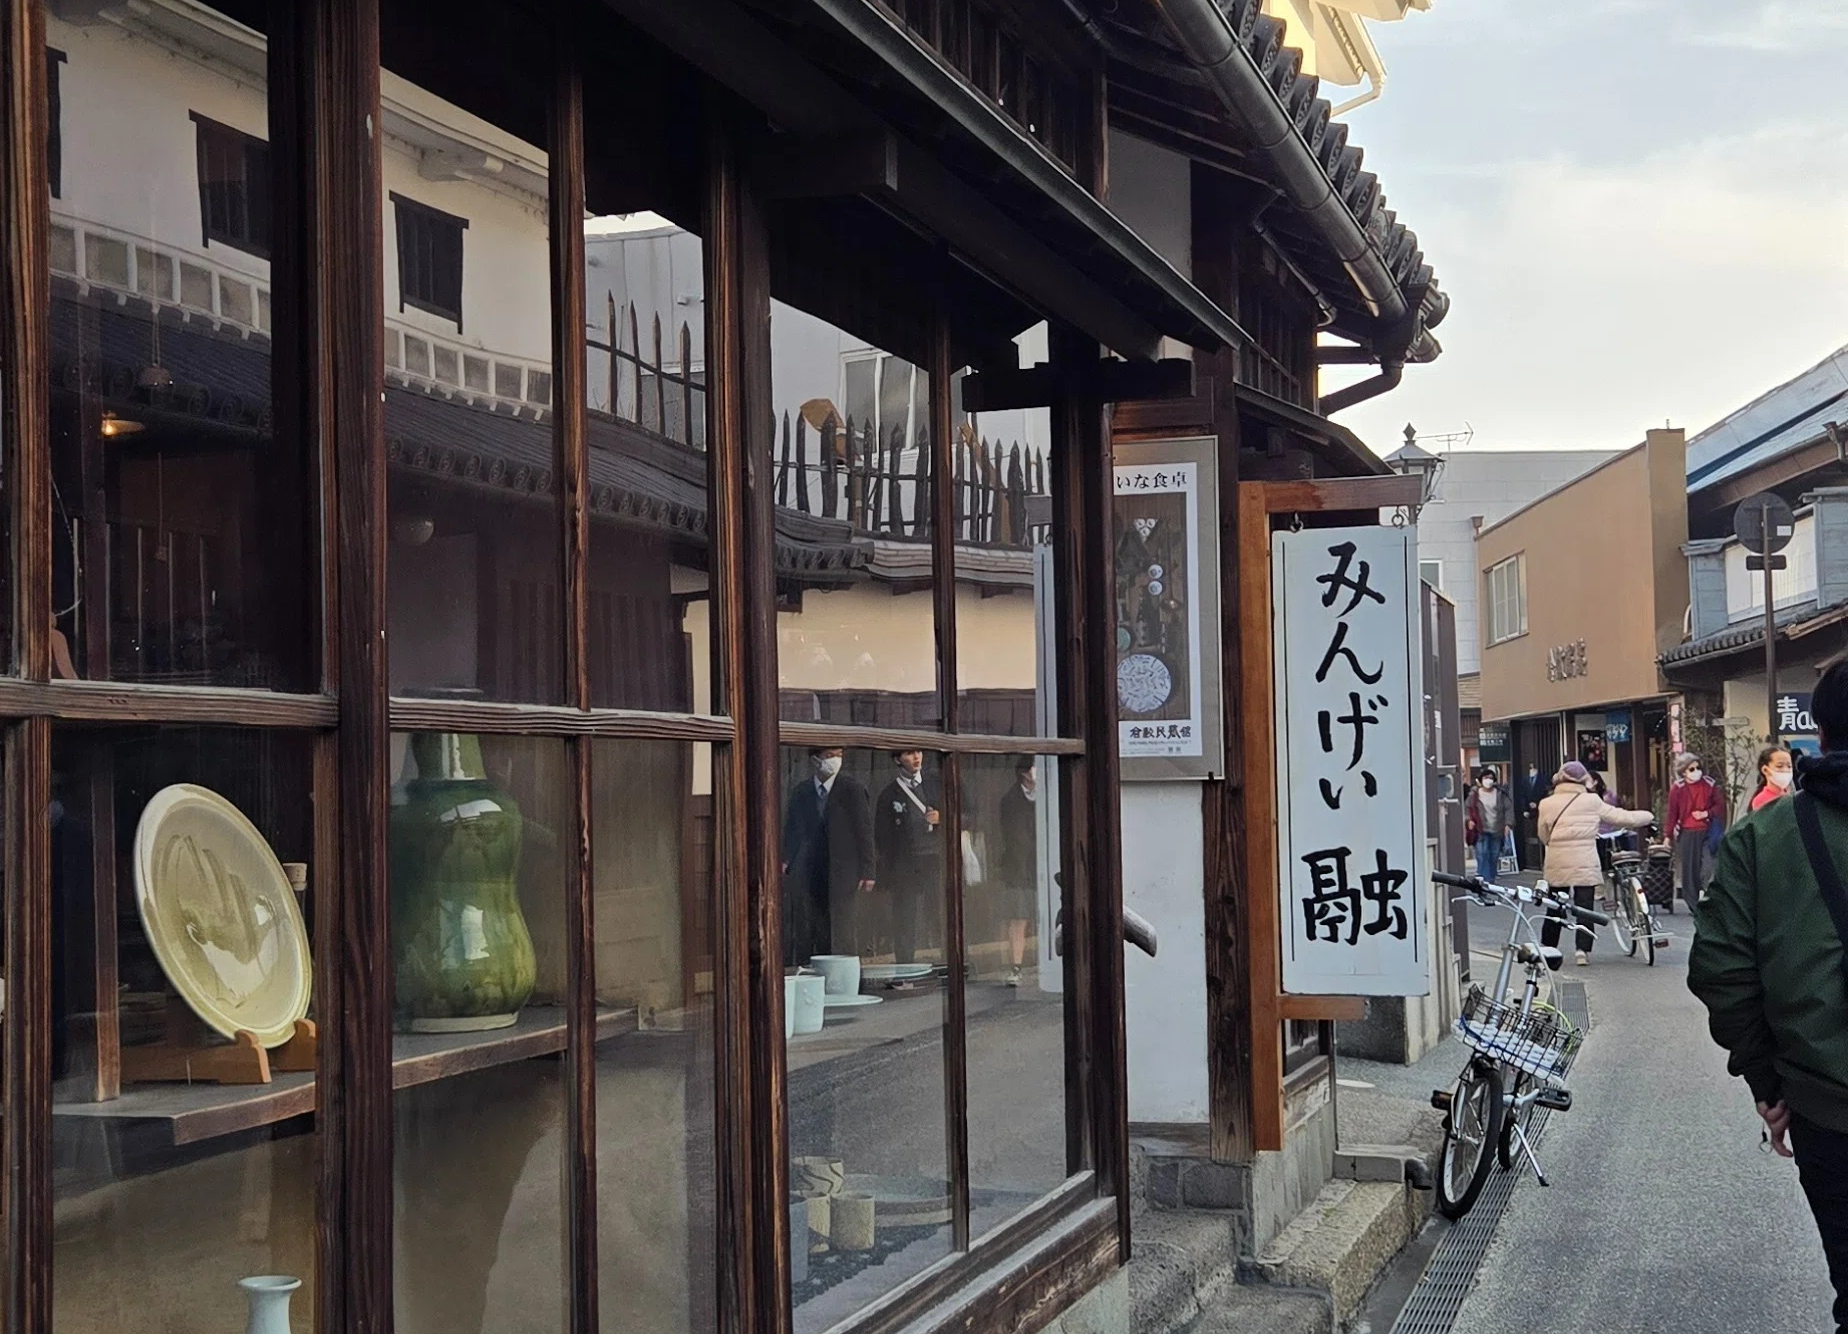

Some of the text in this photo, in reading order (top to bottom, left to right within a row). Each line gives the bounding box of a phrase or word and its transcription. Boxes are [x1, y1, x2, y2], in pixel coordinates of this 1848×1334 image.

[1301, 540, 1408, 946] みんげい 融
